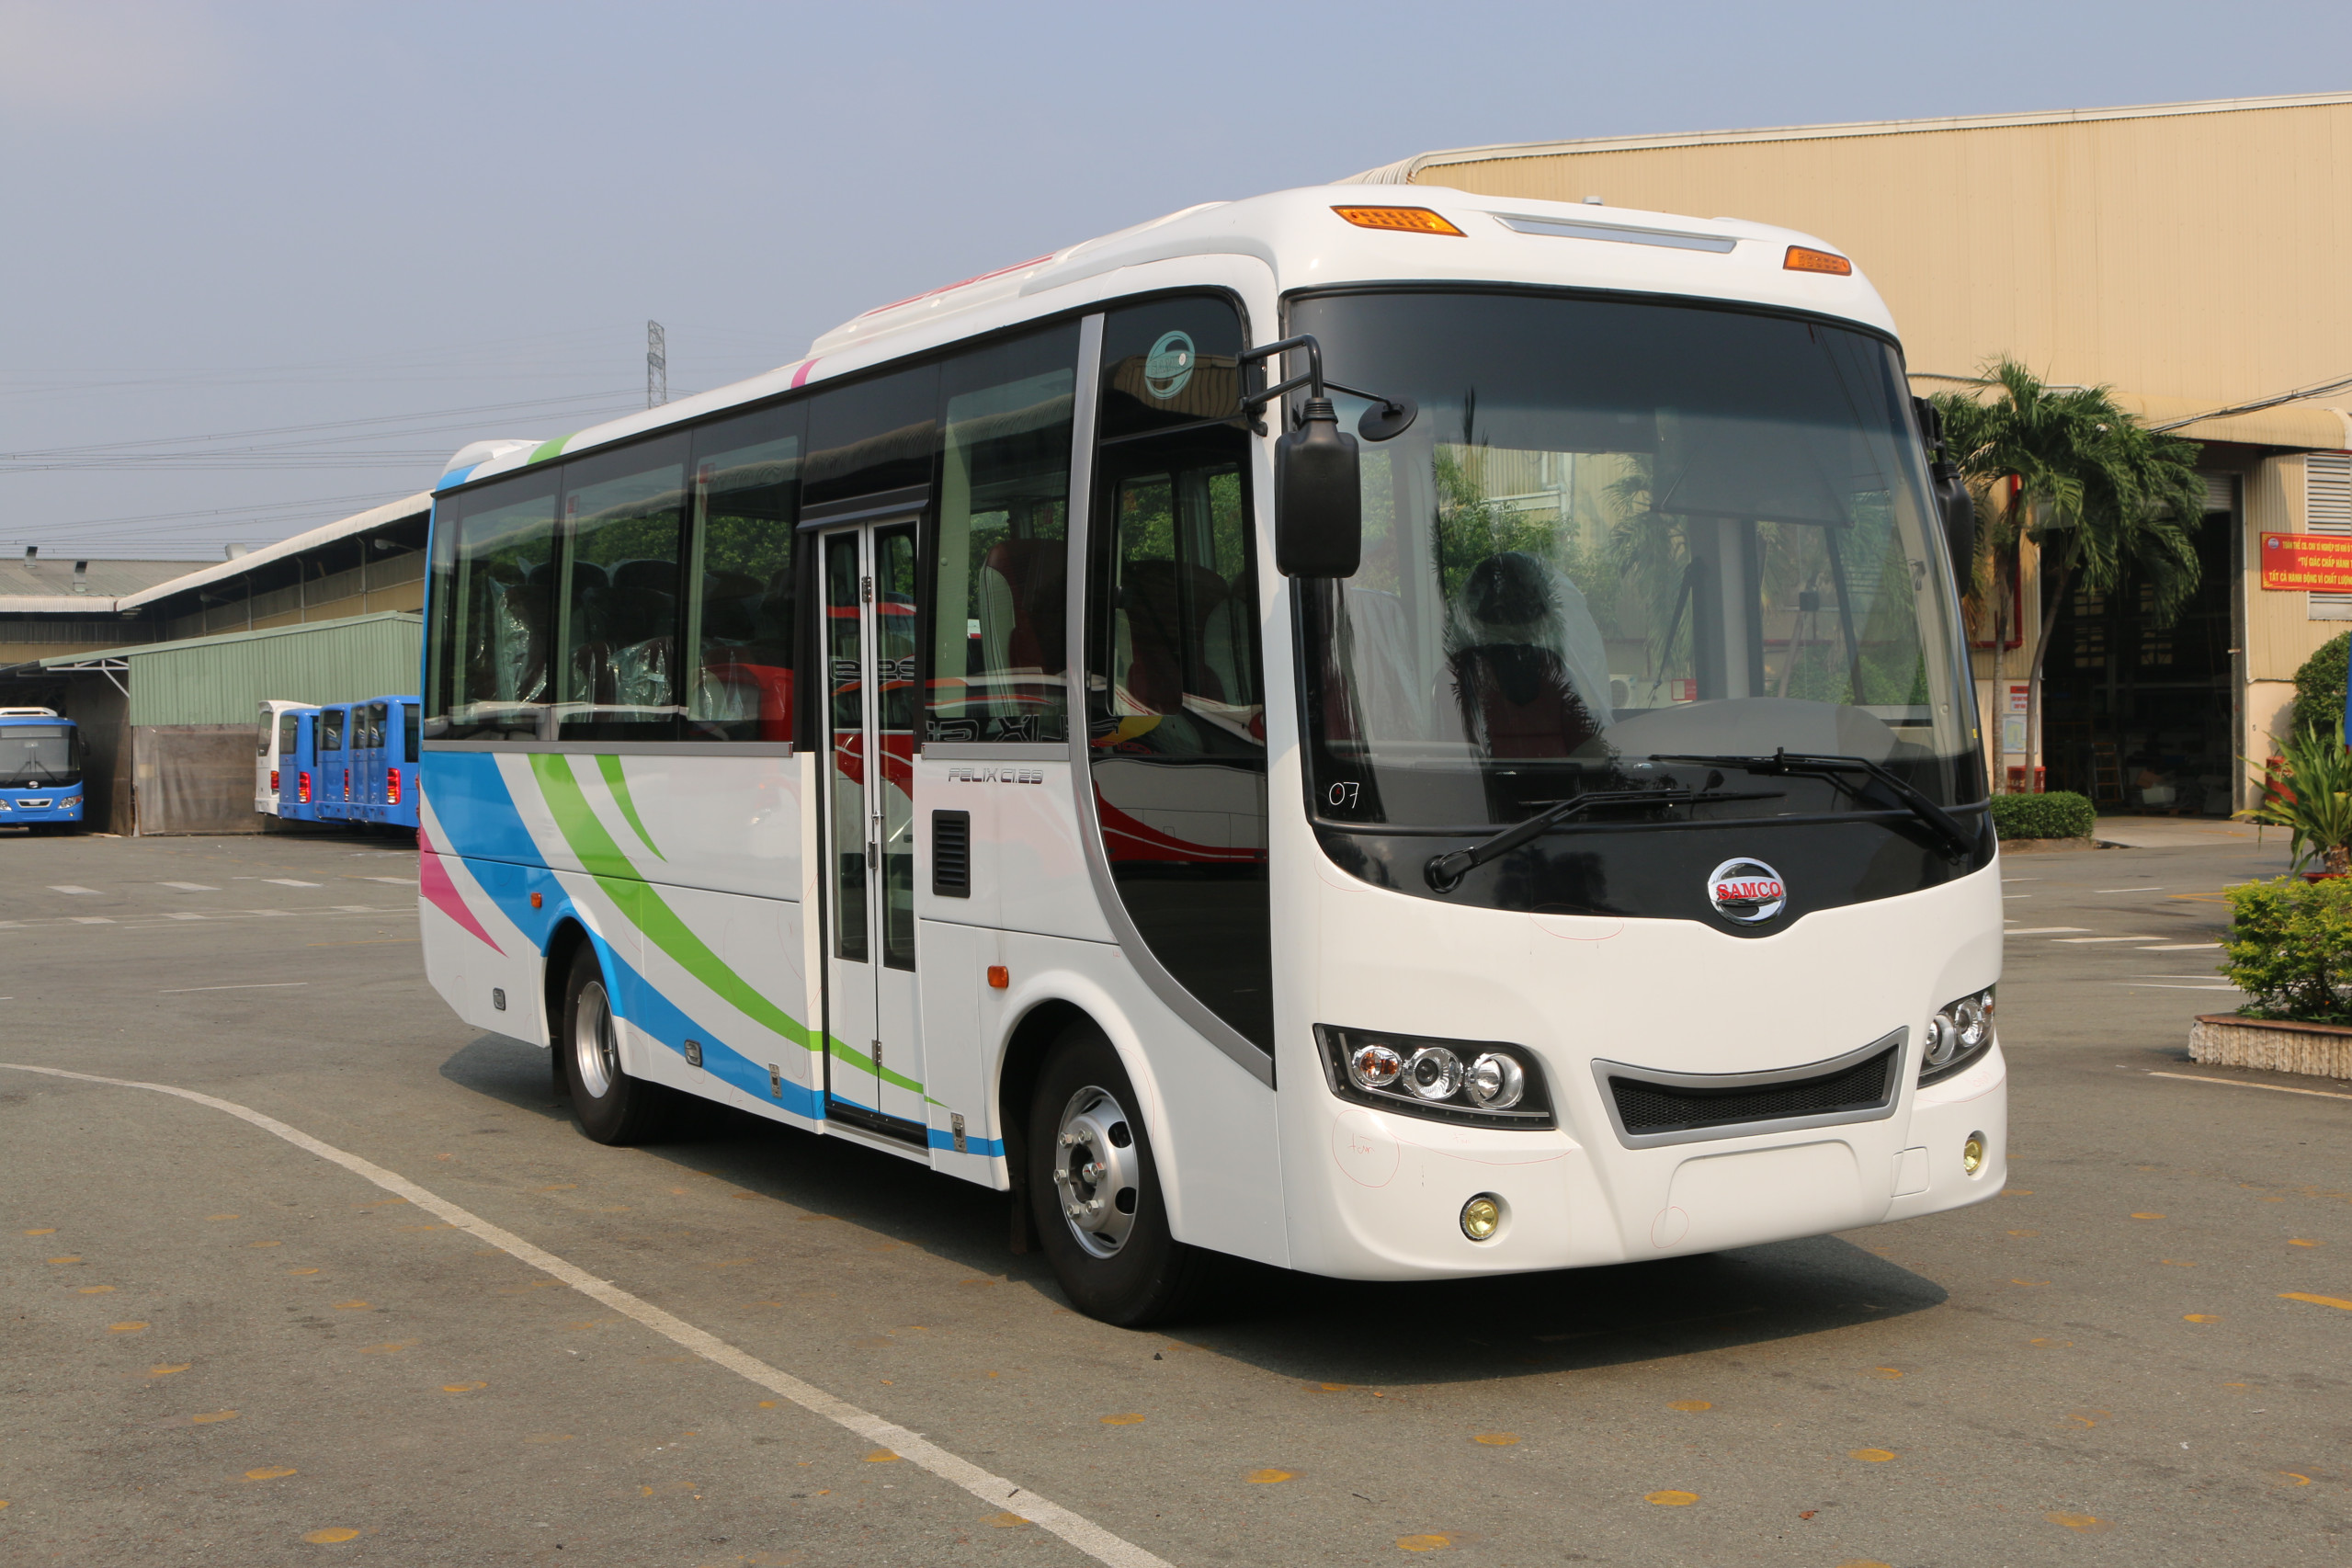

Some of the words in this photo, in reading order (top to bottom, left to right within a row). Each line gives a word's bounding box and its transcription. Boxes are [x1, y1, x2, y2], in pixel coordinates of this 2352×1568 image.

[949, 767, 998, 782] FELIX
[1329, 781, 1359, 809] 07
[1716, 881, 1782, 901] SAMCO
